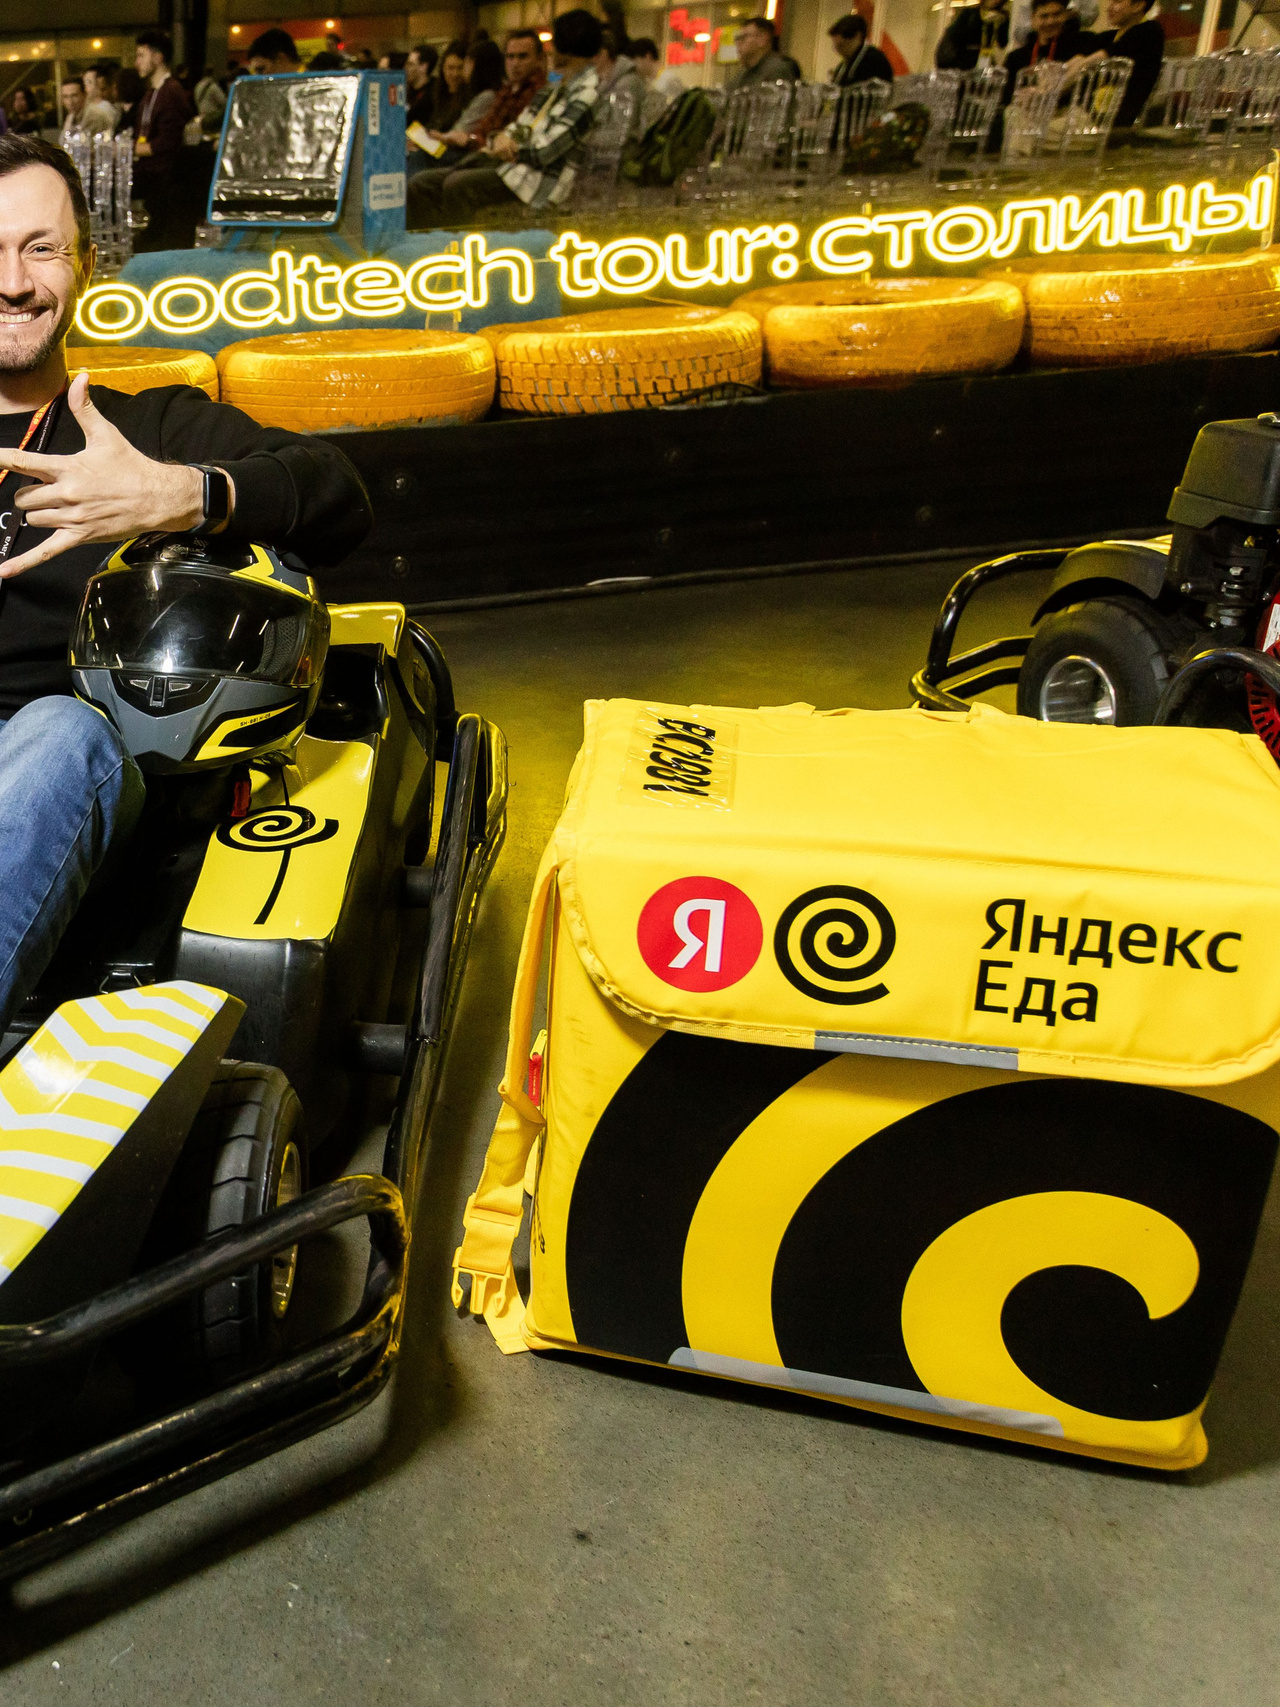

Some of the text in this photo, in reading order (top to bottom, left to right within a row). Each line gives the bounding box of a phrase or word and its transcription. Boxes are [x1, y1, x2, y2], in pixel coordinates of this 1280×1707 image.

[75, 173, 1275, 342] oodtech tour: столицы
[0, 535, 12, 557] Java
[668, 897, 727, 973] Я
[980, 897, 1243, 974] Яндекс
[973, 958, 1100, 1027] Еда
